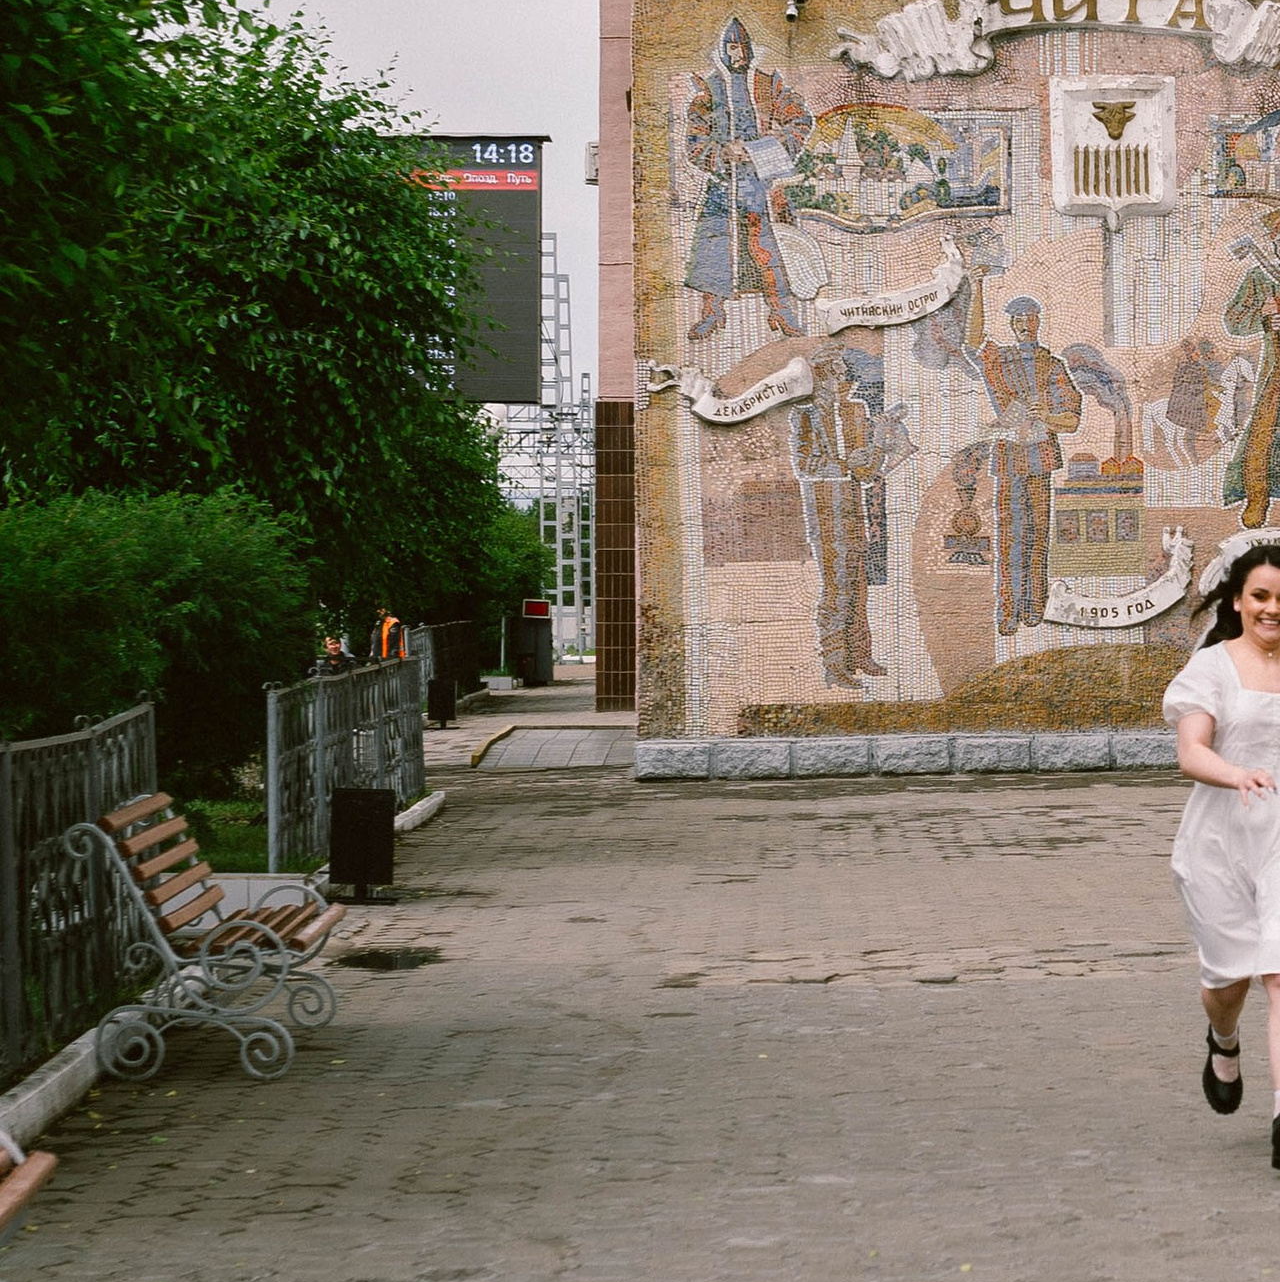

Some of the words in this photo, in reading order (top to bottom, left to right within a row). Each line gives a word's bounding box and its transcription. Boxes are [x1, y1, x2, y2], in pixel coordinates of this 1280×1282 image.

[472, 143, 534, 163] 14:18
[507, 173, 533, 185] Путь
[907, 290, 938, 311] ОСТРОГ
[713, 381, 788, 416] ДЕКАБРИСТЫ
[1080, 606, 1119, 619] 1905
[1127, 599, 1155, 616] ГОД
